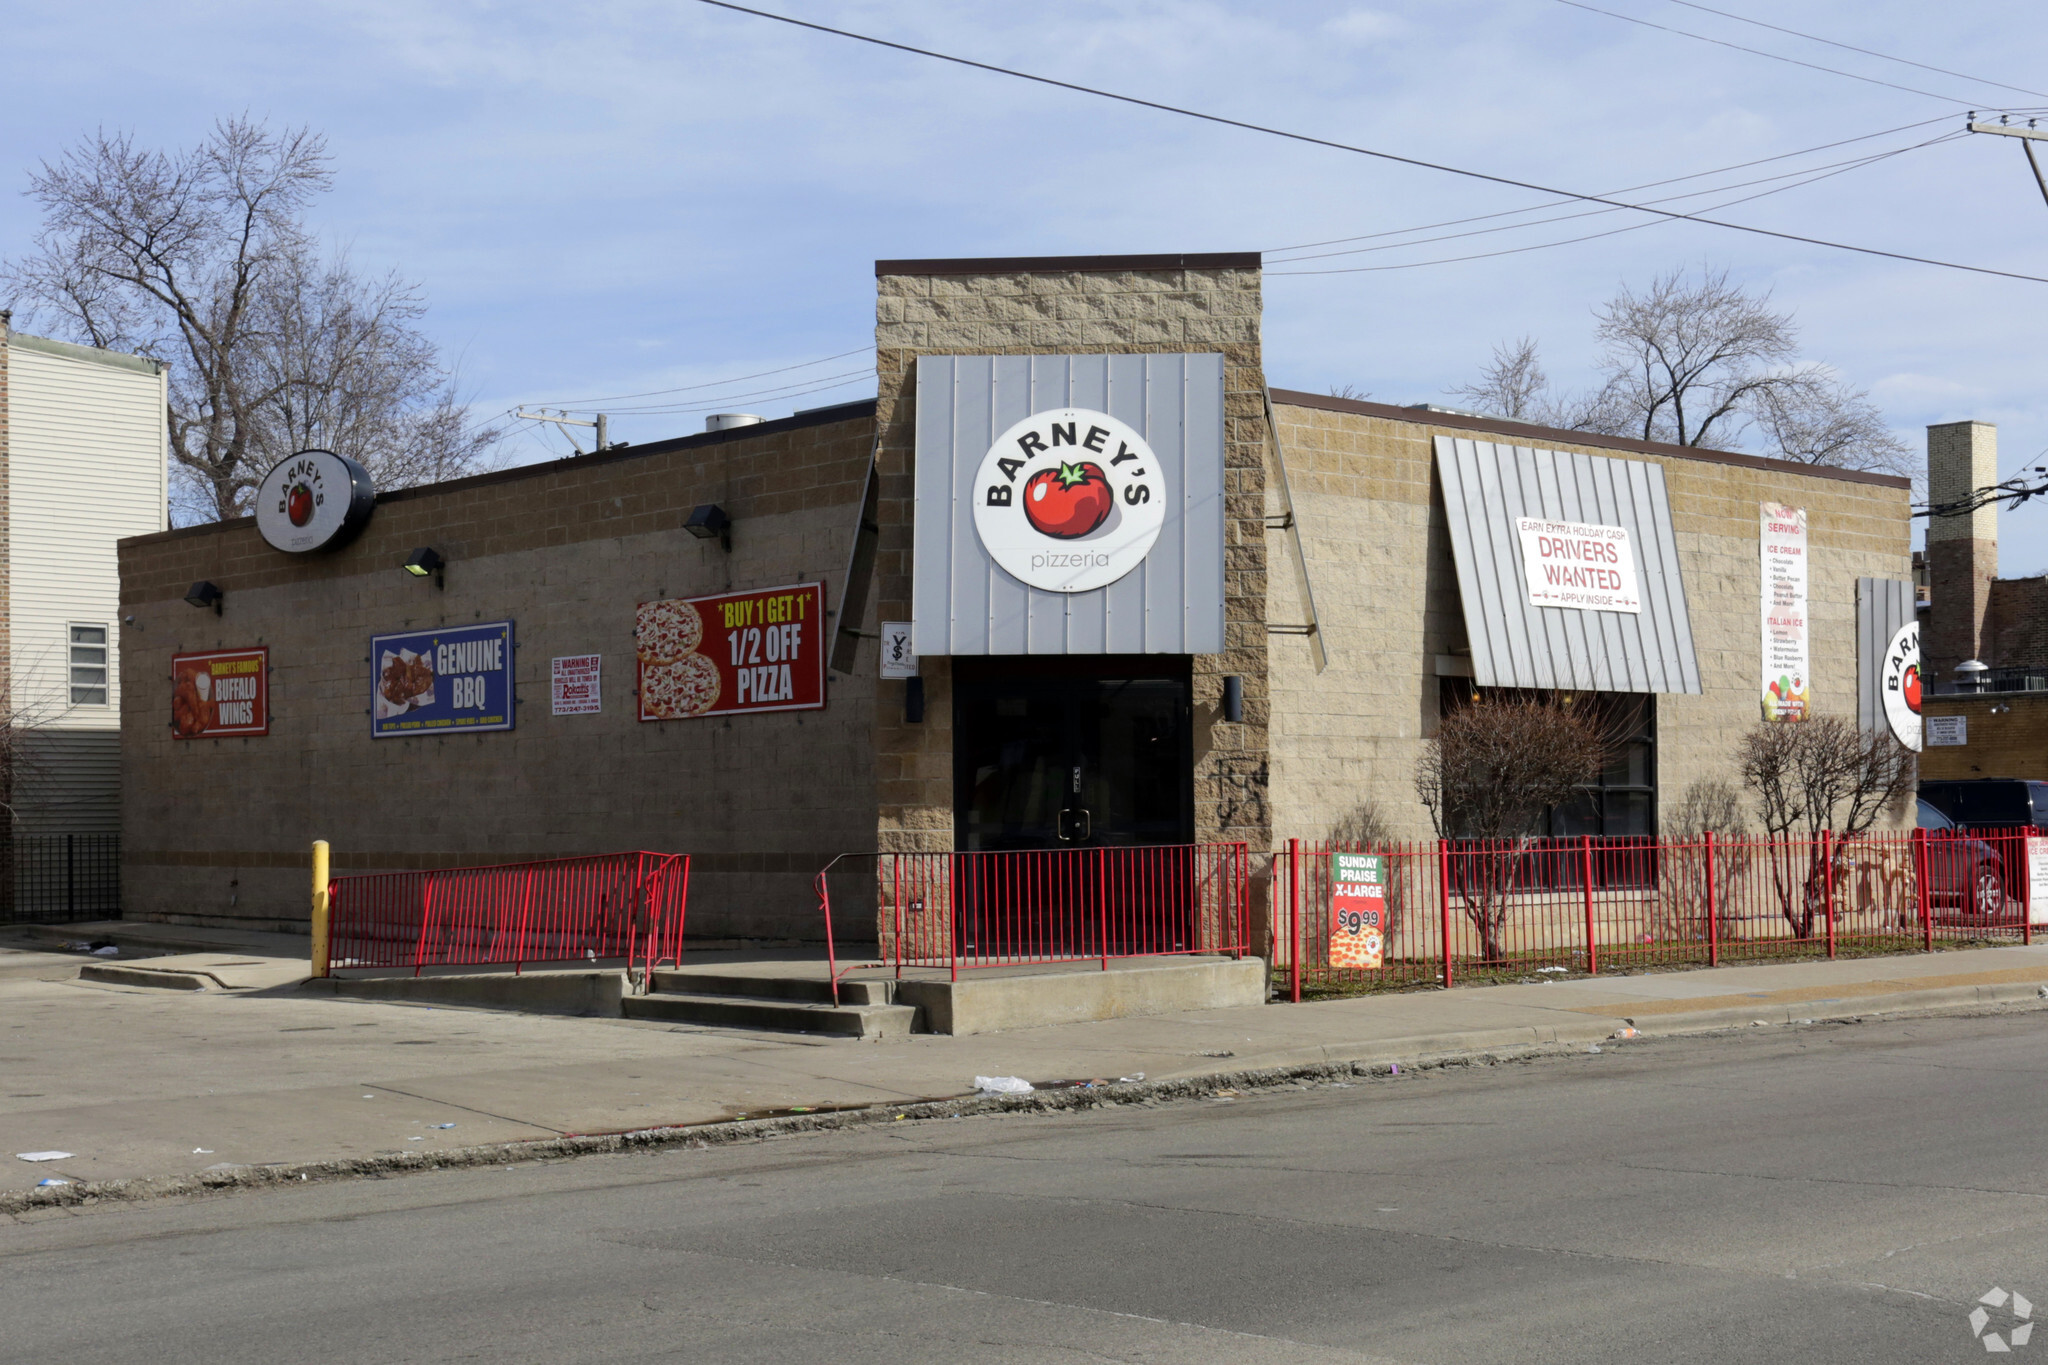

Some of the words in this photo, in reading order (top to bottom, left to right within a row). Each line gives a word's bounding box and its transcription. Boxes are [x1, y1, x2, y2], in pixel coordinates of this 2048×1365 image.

[986, 422, 1150, 507] BARNEY'S
[279, 459, 324, 513] BARNEY'S
[1521, 521, 1544, 532] EARN
[1546, 523, 1571, 535] EXTRA
[1573, 526, 1604, 538] HOLIDAY
[1606, 529, 1625, 540] CASH
[1768, 522, 1800, 535] SERVING
[1538, 536, 1618, 563] DRIVERS
[1767, 545, 1778, 553] ICE
[1780, 546, 1801, 555] CREAM
[1031, 552, 1109, 571] pizzeria
[1543, 563, 1621, 590] WANTED
[1561, 593, 1585, 603] APPLY
[1586, 595, 1613, 605] INSIDE
[724, 600, 753, 629] BUY
[757, 598, 763, 624] 1
[767, 595, 794, 624] GET
[797, 594, 804, 620] 1
[1767, 617, 1792, 626] ITALIAN
[1793, 618, 1803, 627] ICE
[728, 627, 761, 666] 1/2
[765, 623, 801, 662] OFF
[1773, 637, 1797, 645] Strawberry
[237, 660, 259, 673] FAMOUS
[437, 639, 502, 676] GENUINE
[562, 657, 590, 669] WARNING
[215, 676, 257, 701] BUFFALO
[453, 675, 486, 711] BBQ
[737, 664, 793, 703] PIZZA
[219, 701, 253, 725] WINGS
[1339, 856, 1377, 869] SUNDAY
[1340, 869, 1377, 882] PRAISE
[1335, 884, 1382, 898] X-LARGE
